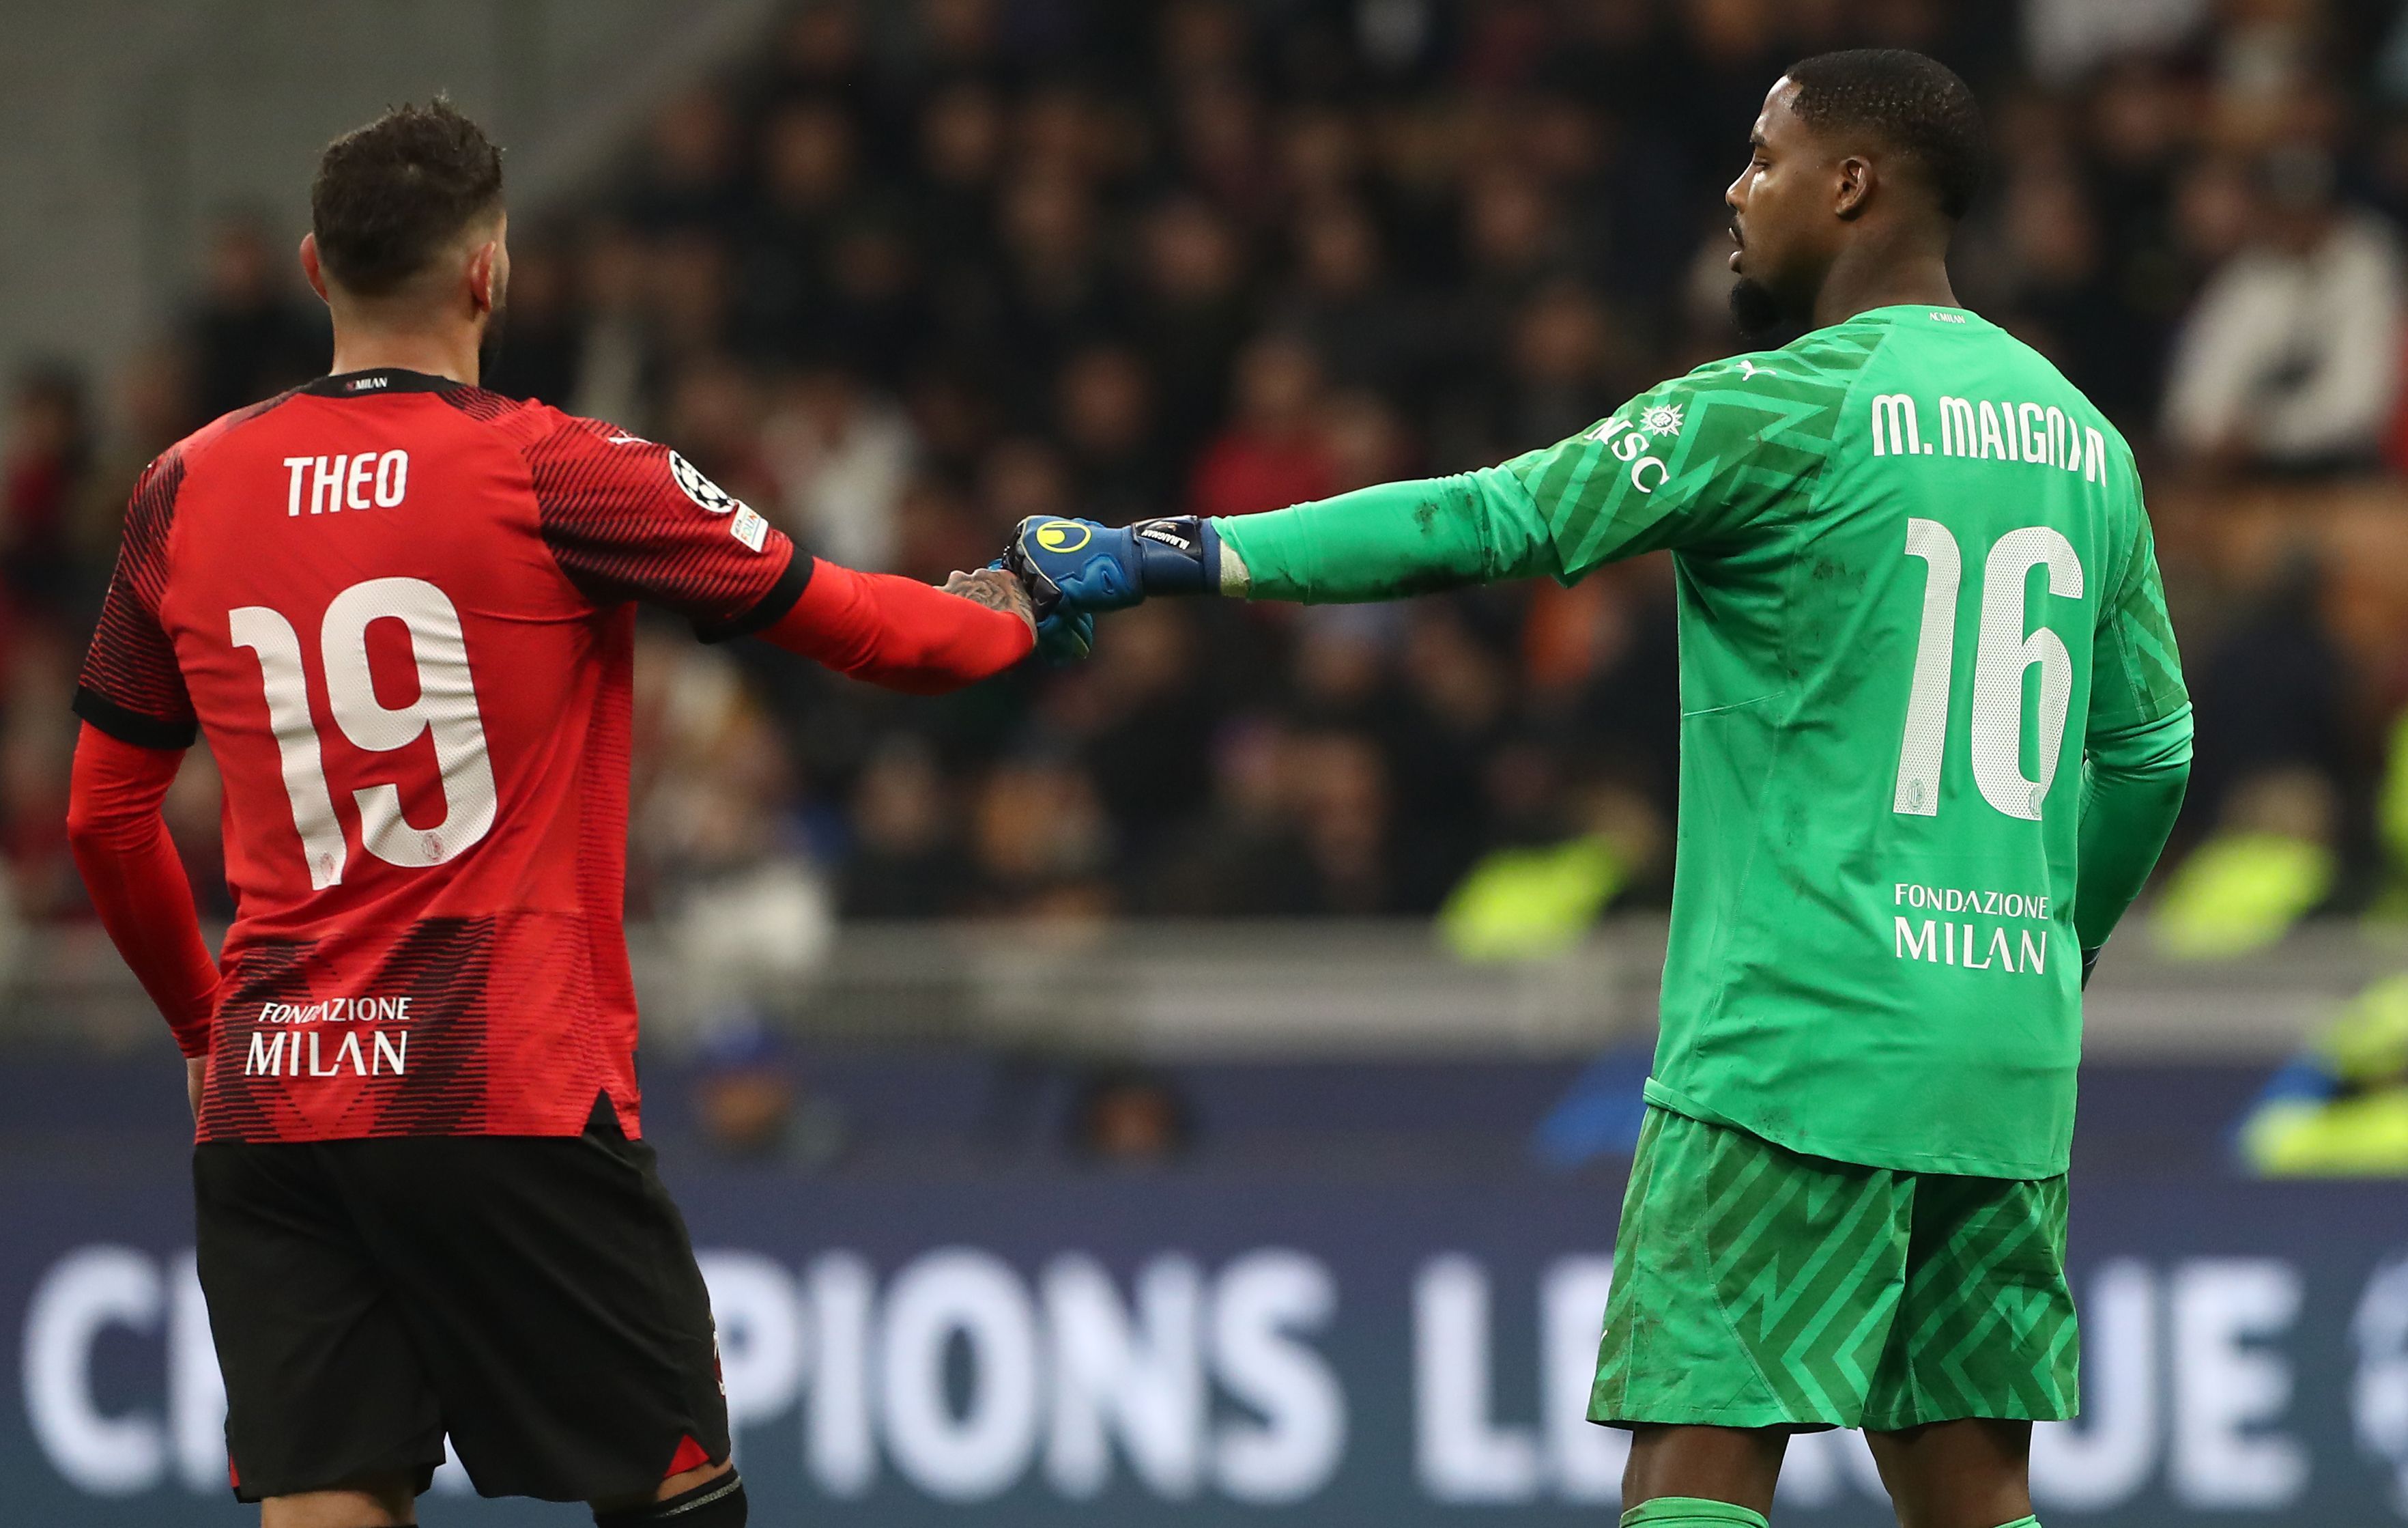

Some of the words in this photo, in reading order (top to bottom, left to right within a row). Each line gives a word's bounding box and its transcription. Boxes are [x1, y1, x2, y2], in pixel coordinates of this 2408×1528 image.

[1939, 313, 1966, 324] MILAN
[355, 377, 388, 390] MILAN
[283, 449, 409, 517] THEO
[1583, 416, 1671, 493] MSC
[1893, 517, 2084, 821] 16
[228, 576, 498, 891] 19
[1894, 883, 2048, 920] FONDAZIONE
[1894, 916, 2047, 975] MILAN
[258, 996, 412, 1024] FONDAZIONE
[244, 1030, 407, 1076] MILAN
[23, 1244, 1346, 1501] CPIONS
